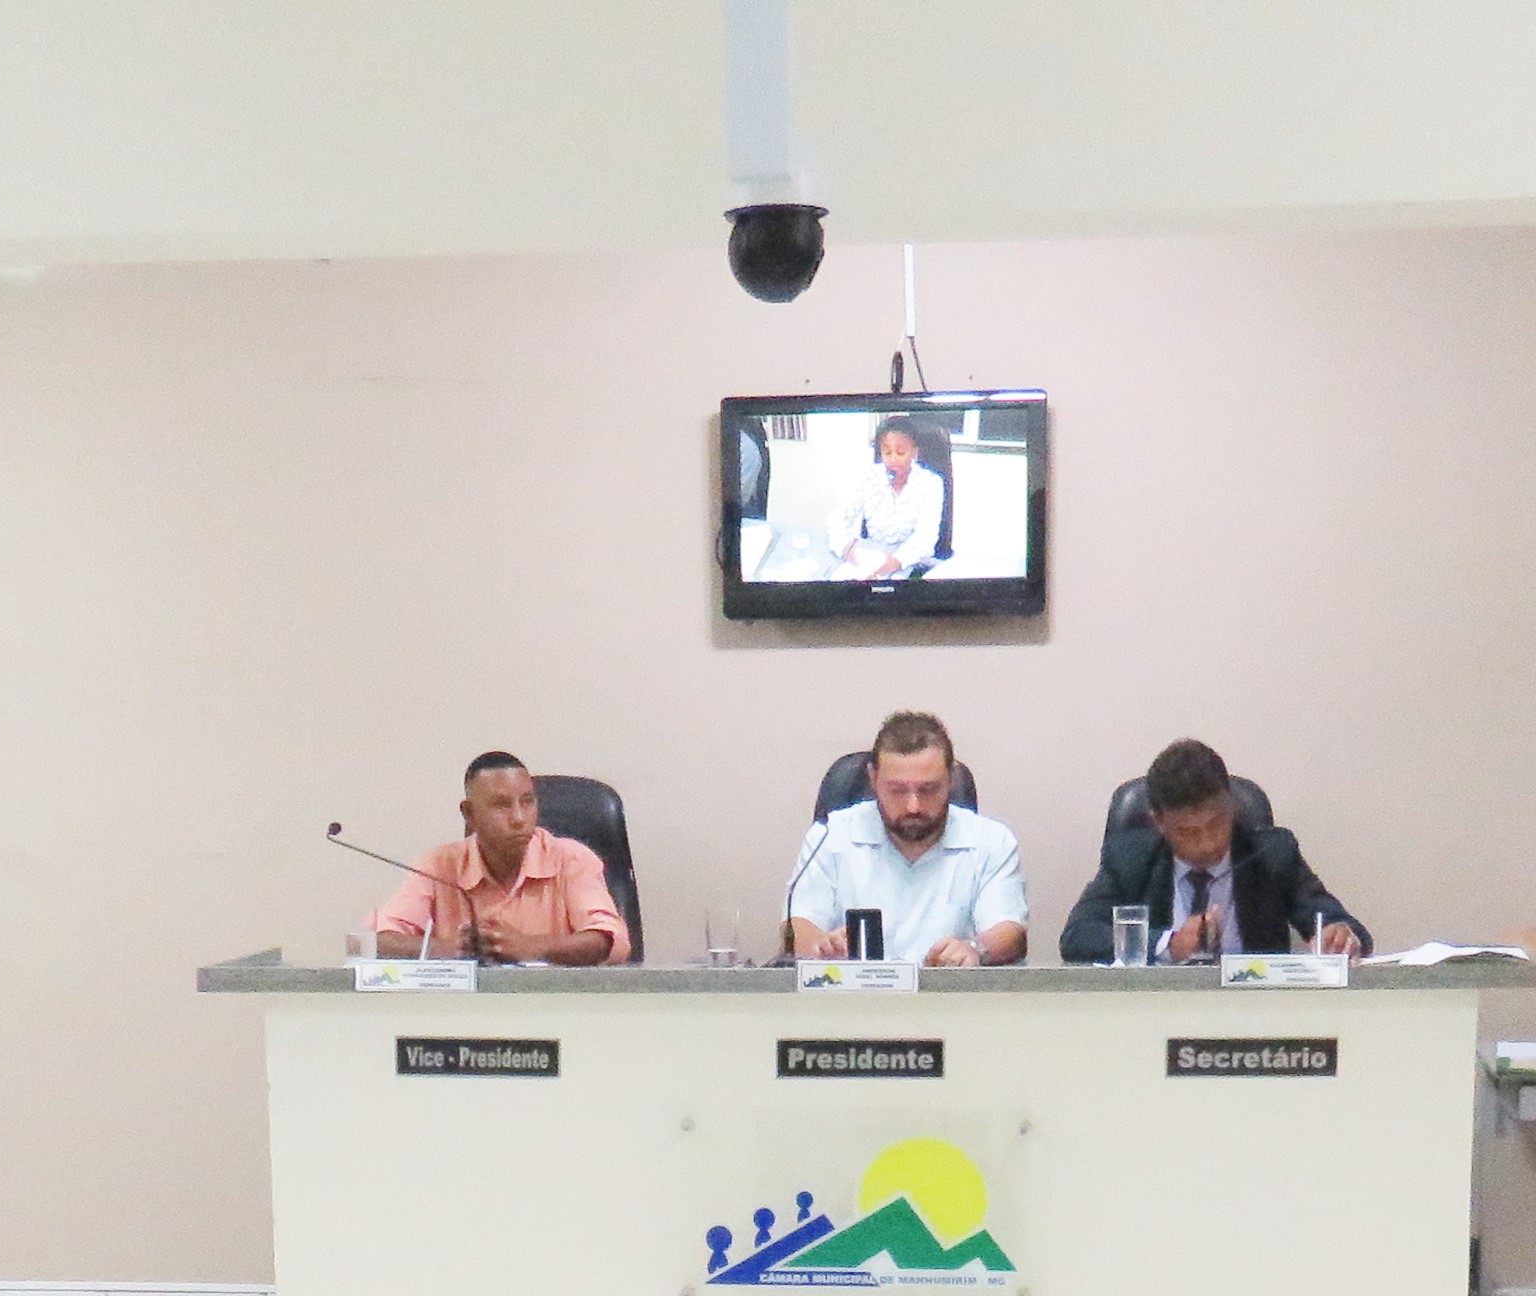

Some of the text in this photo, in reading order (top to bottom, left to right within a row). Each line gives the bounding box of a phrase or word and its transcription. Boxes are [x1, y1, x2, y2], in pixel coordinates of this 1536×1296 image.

[405, 1045, 445, 1067] Vice
[458, 1046, 550, 1070] Presidente
[787, 1047, 935, 1070] Presidente
[1176, 1045, 1328, 1070] Secretário
[812, 1273, 879, 1285] MUNICIPAL
[879, 1275, 895, 1285] DE
